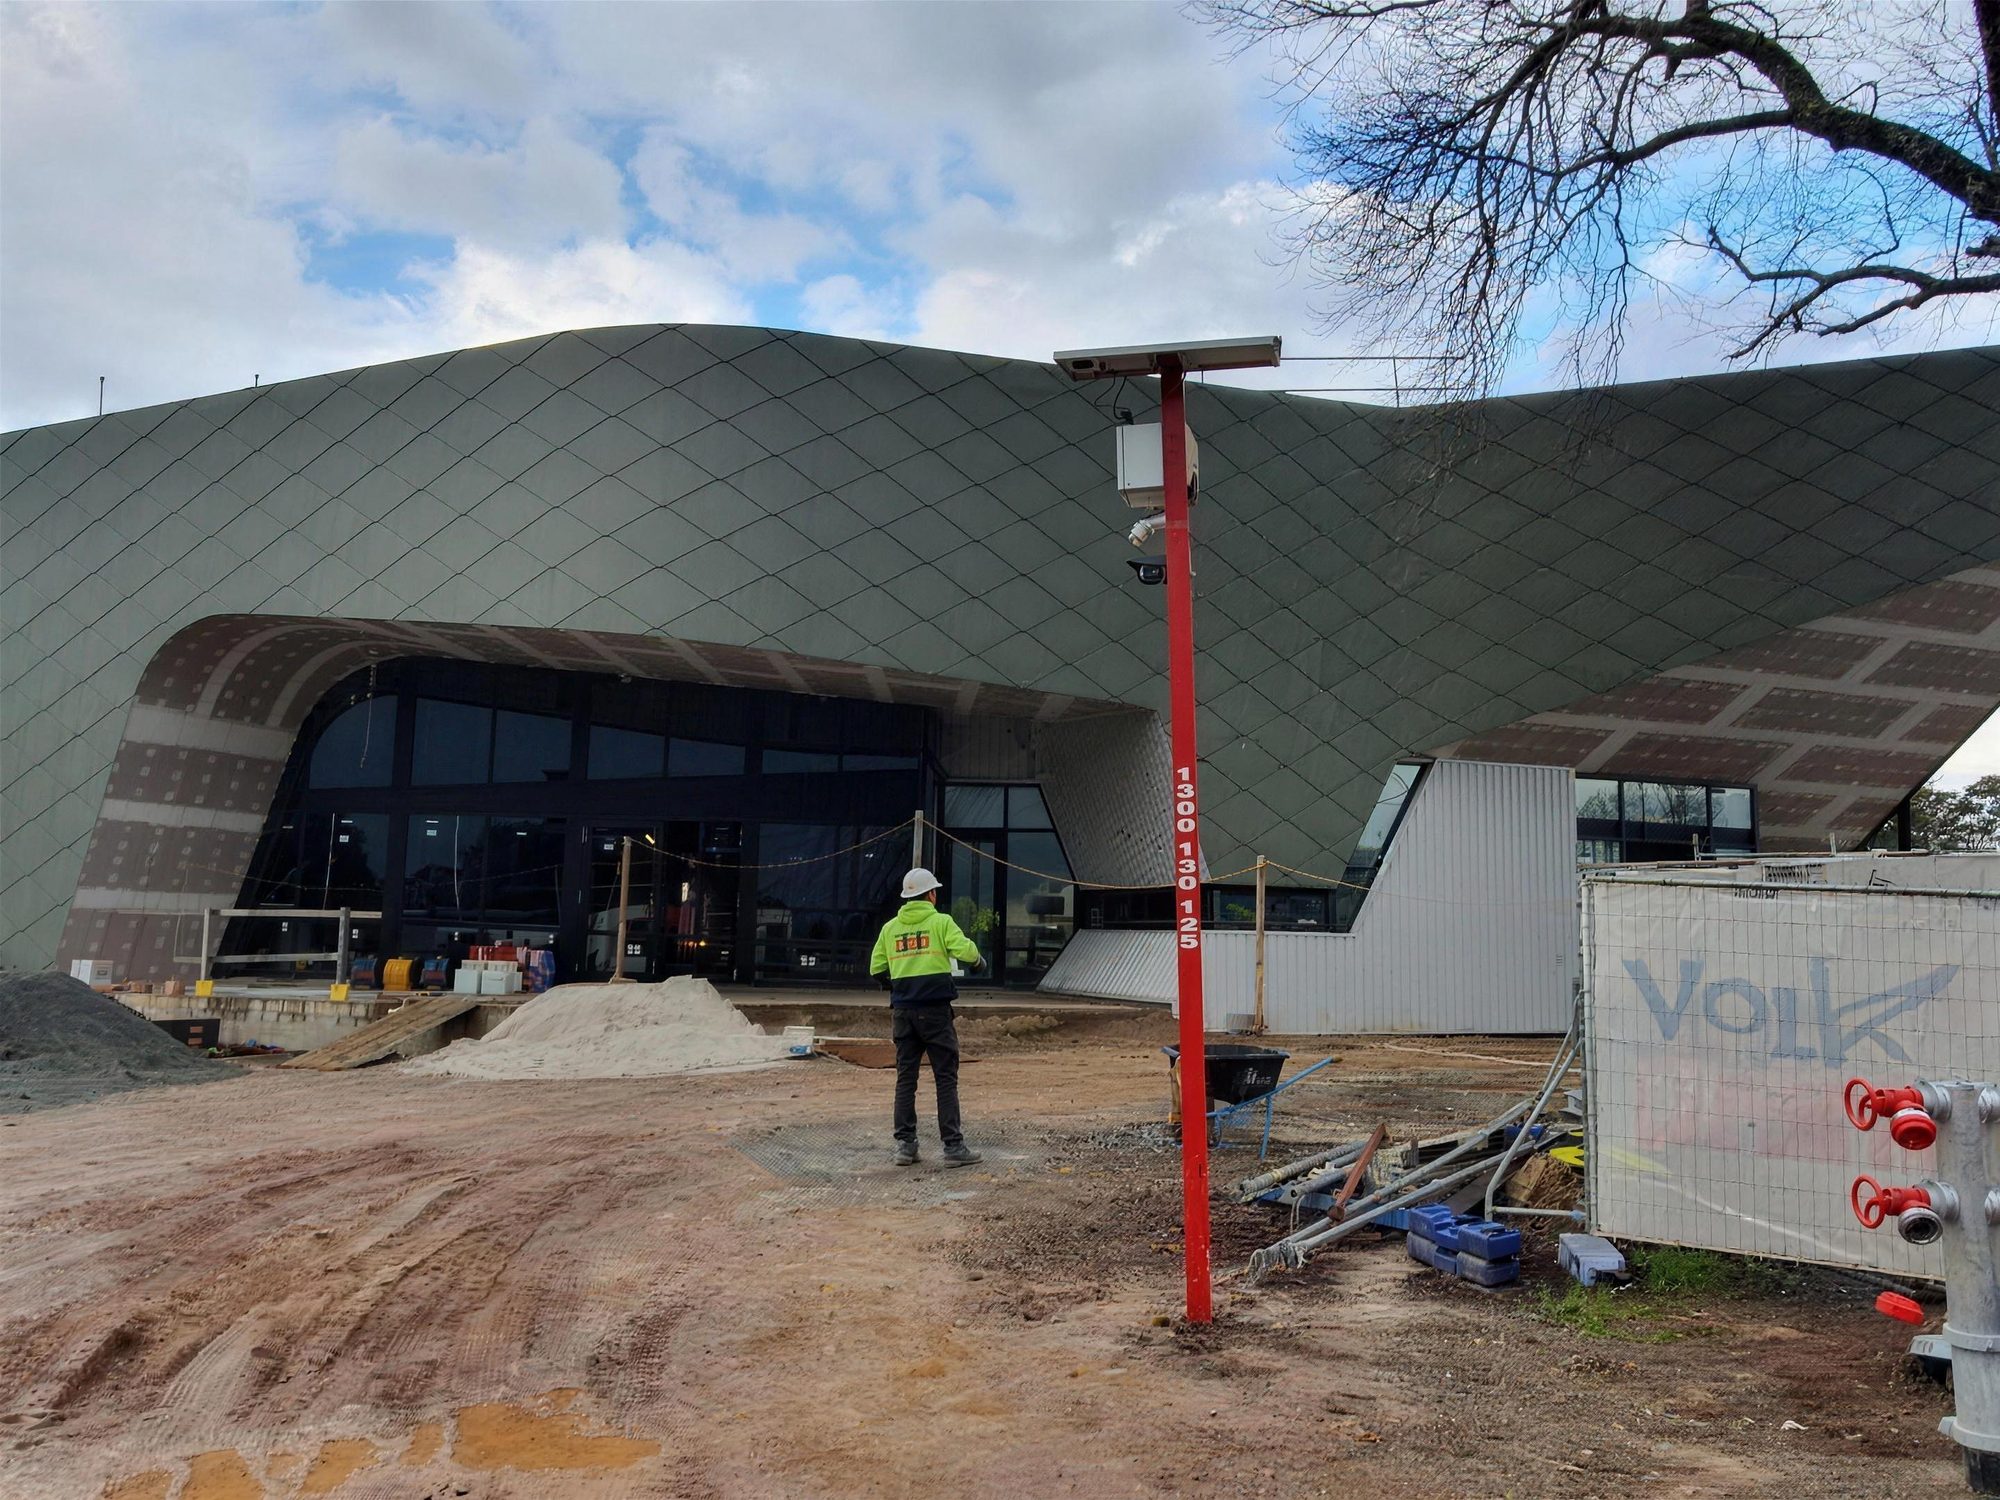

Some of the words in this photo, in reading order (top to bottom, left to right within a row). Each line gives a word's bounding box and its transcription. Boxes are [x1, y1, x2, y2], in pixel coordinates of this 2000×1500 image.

[1176, 767, 1196, 833] 1300
[1178, 842, 1197, 890] 130
[1180, 900, 1199, 949] 125
